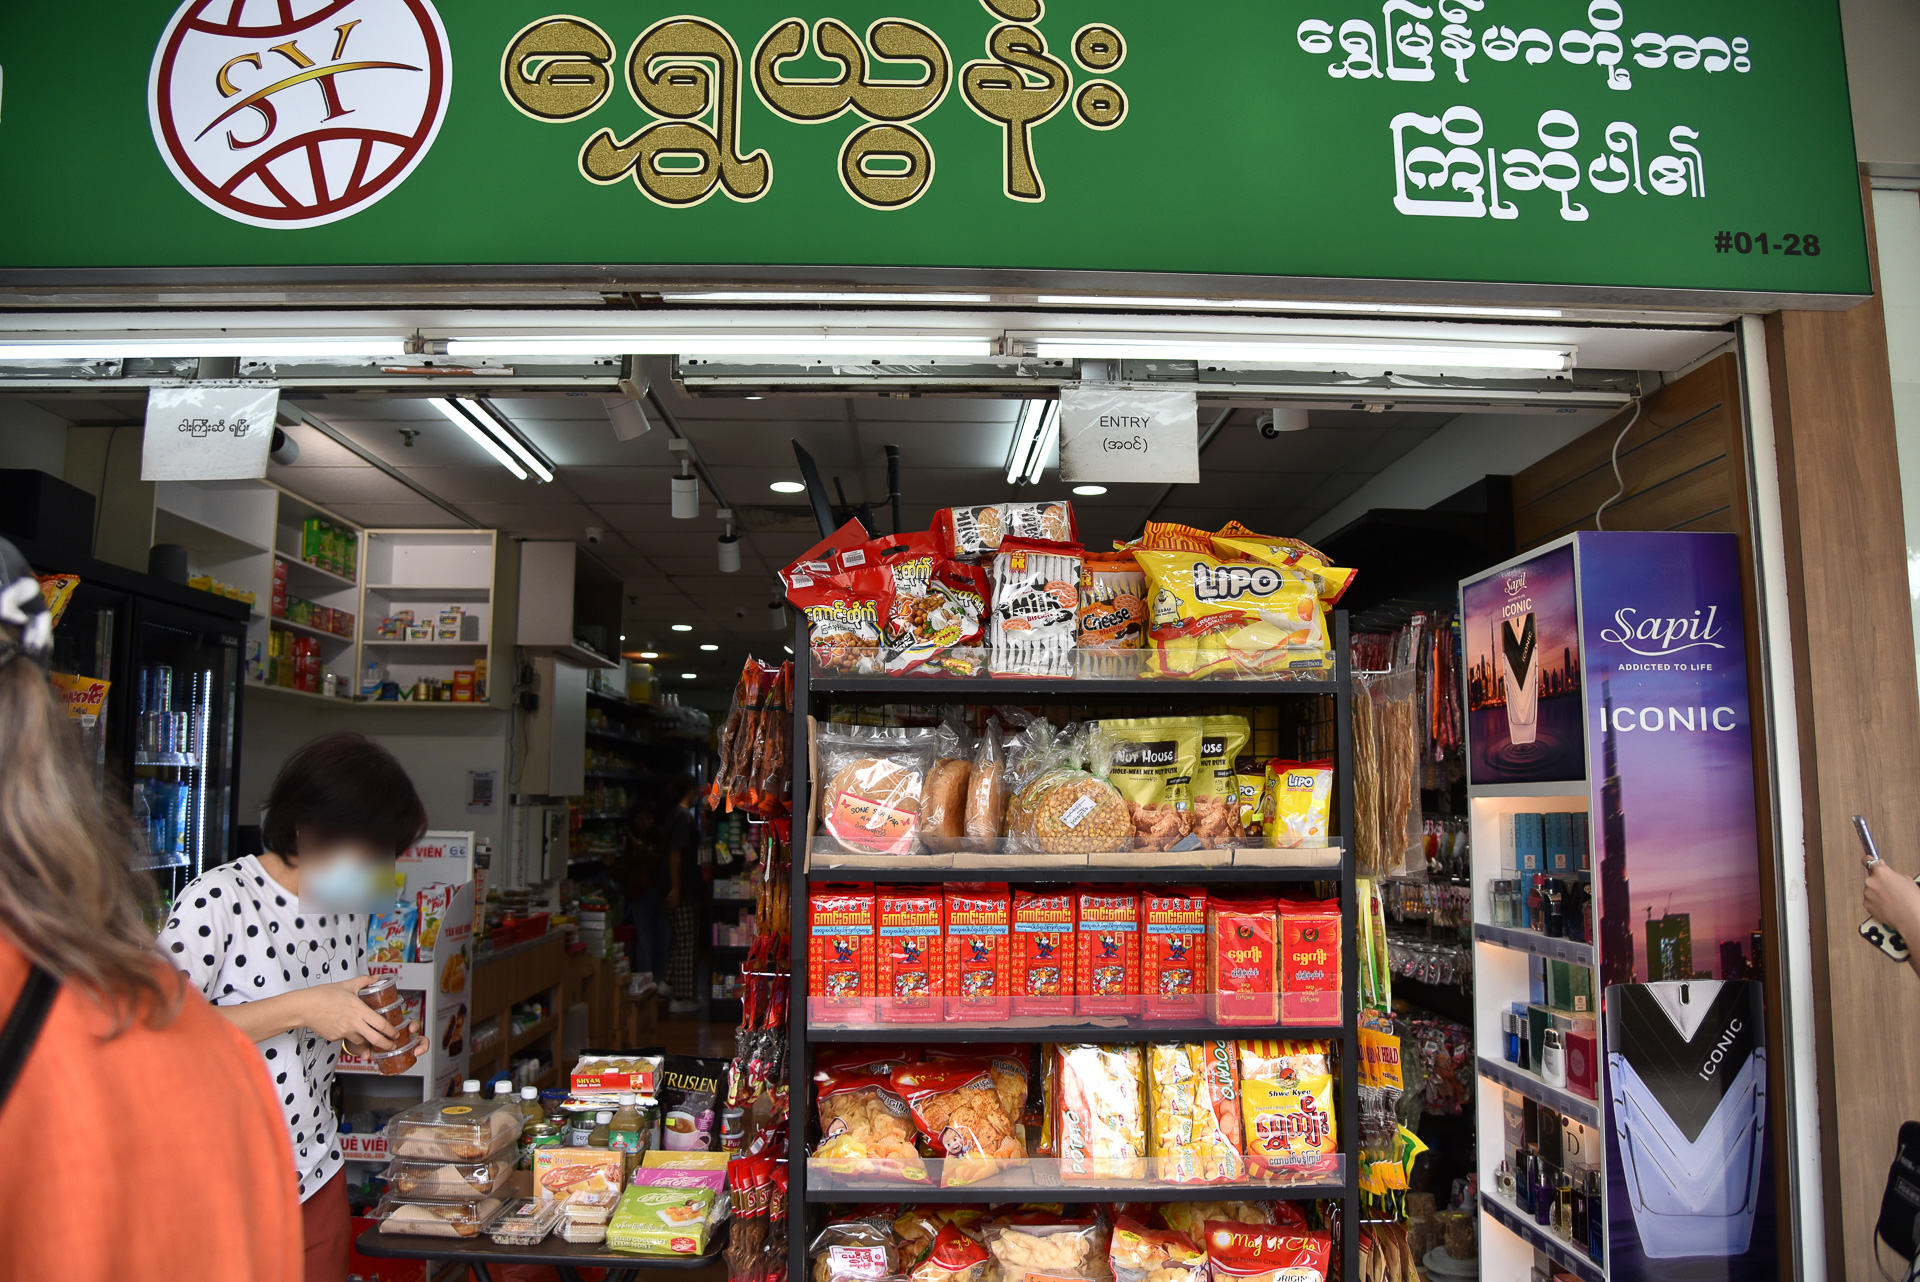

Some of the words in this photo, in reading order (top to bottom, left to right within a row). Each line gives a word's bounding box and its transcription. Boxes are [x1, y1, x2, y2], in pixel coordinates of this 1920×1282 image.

[1714, 230, 1821, 257] #01-28
[1100, 416, 1150, 428] ENTRY
[1503, 571, 1528, 596] Sapil
[1502, 597, 1533, 618] ICONIC
[1082, 607, 1131, 631] Cheese
[1196, 615, 1218, 628] CREAM
[1600, 605, 1726, 656] Sapil
[1521, 629, 1533, 662] ICONIC
[1618, 663, 1670, 671] ADDICTED
[1674, 663, 1687, 671] TO
[1690, 663, 1713, 671] LIFE
[1600, 706, 1736, 732] ICONIC
[416, 844, 443, 858] VIÊN
[814, 910, 870, 925] ကောင်းကောင်း
[882, 911, 938, 925] ကောင်းကောင်း
[951, 910, 1007, 924] ကောင်းကောင်း
[1016, 908, 1071, 923] ကောင်းကောင်း
[1081, 906, 1136, 920] ကောင်းကောင်း
[1149, 909, 1204, 924] ကောင်းကောင်း
[1699, 1017, 1743, 1083] ICONIC
[992, 1060, 1023, 1075] RIGINAL
[663, 1071, 718, 1094] TRUSLEN
[1292, 1089, 1311, 1098] Kyee
[341, 1136, 358, 1151] UÊ
[1566, 1131, 1580, 1155] D
[1231, 1233, 1263, 1256] May
[1286, 1236, 1316, 1251] Cho
[1240, 1256, 1261, 1264] Potato
[1263, 1258, 1282, 1266] Chips
